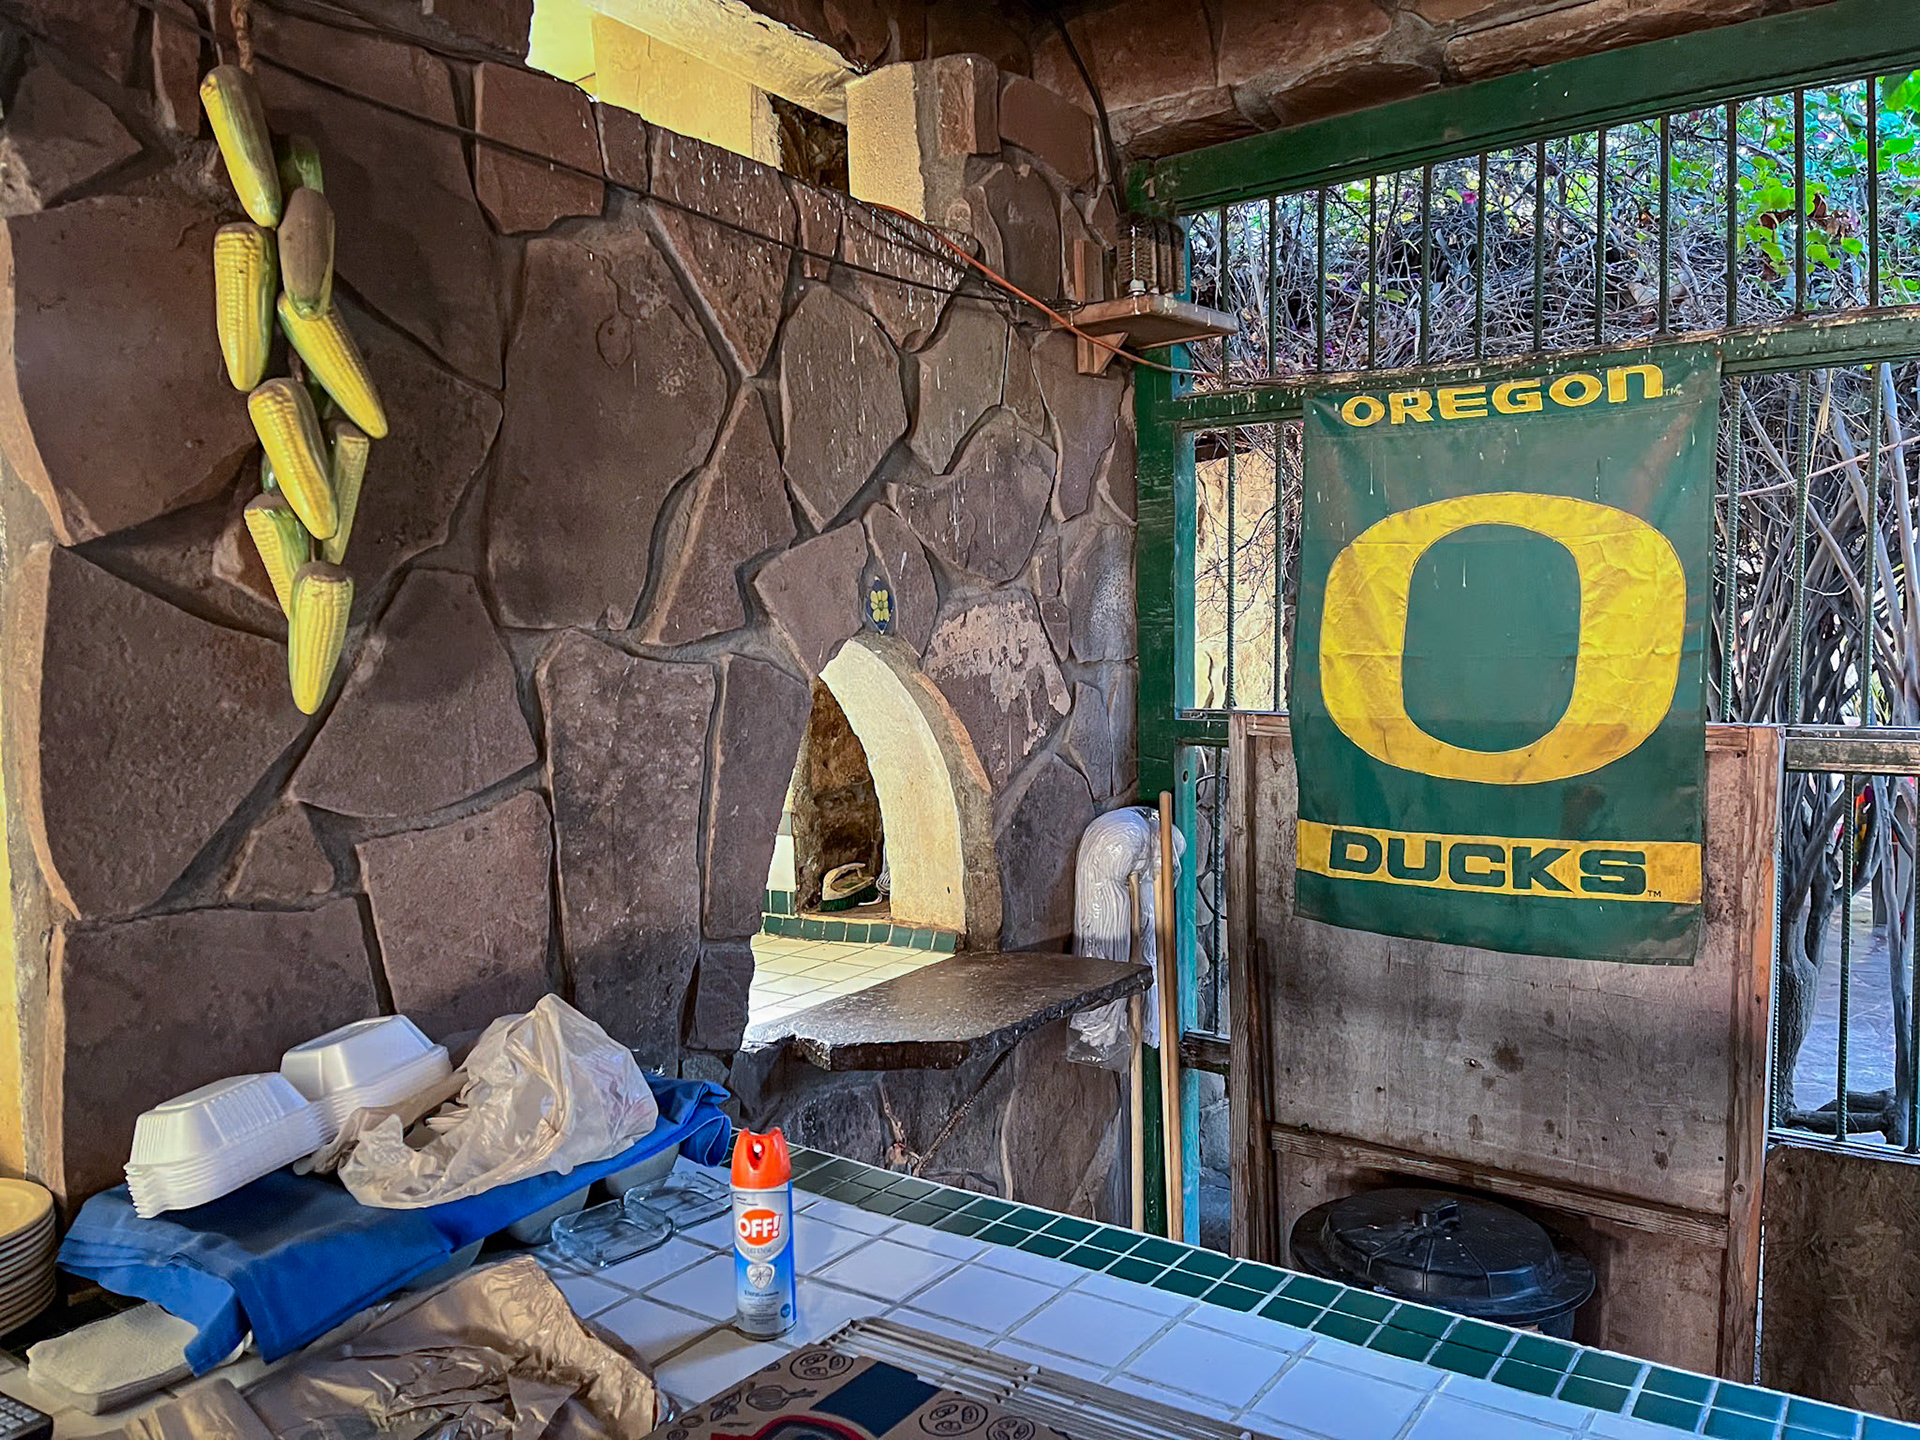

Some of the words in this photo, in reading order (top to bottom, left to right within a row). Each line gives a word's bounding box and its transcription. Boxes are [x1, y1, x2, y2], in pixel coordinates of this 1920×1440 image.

[1341, 364, 1664, 427] OREGON
[1319, 491, 1686, 785] O
[1329, 829, 1646, 896] DUCKS
[1647, 889, 1662, 897] TM
[738, 1215, 780, 1238] OFF!
